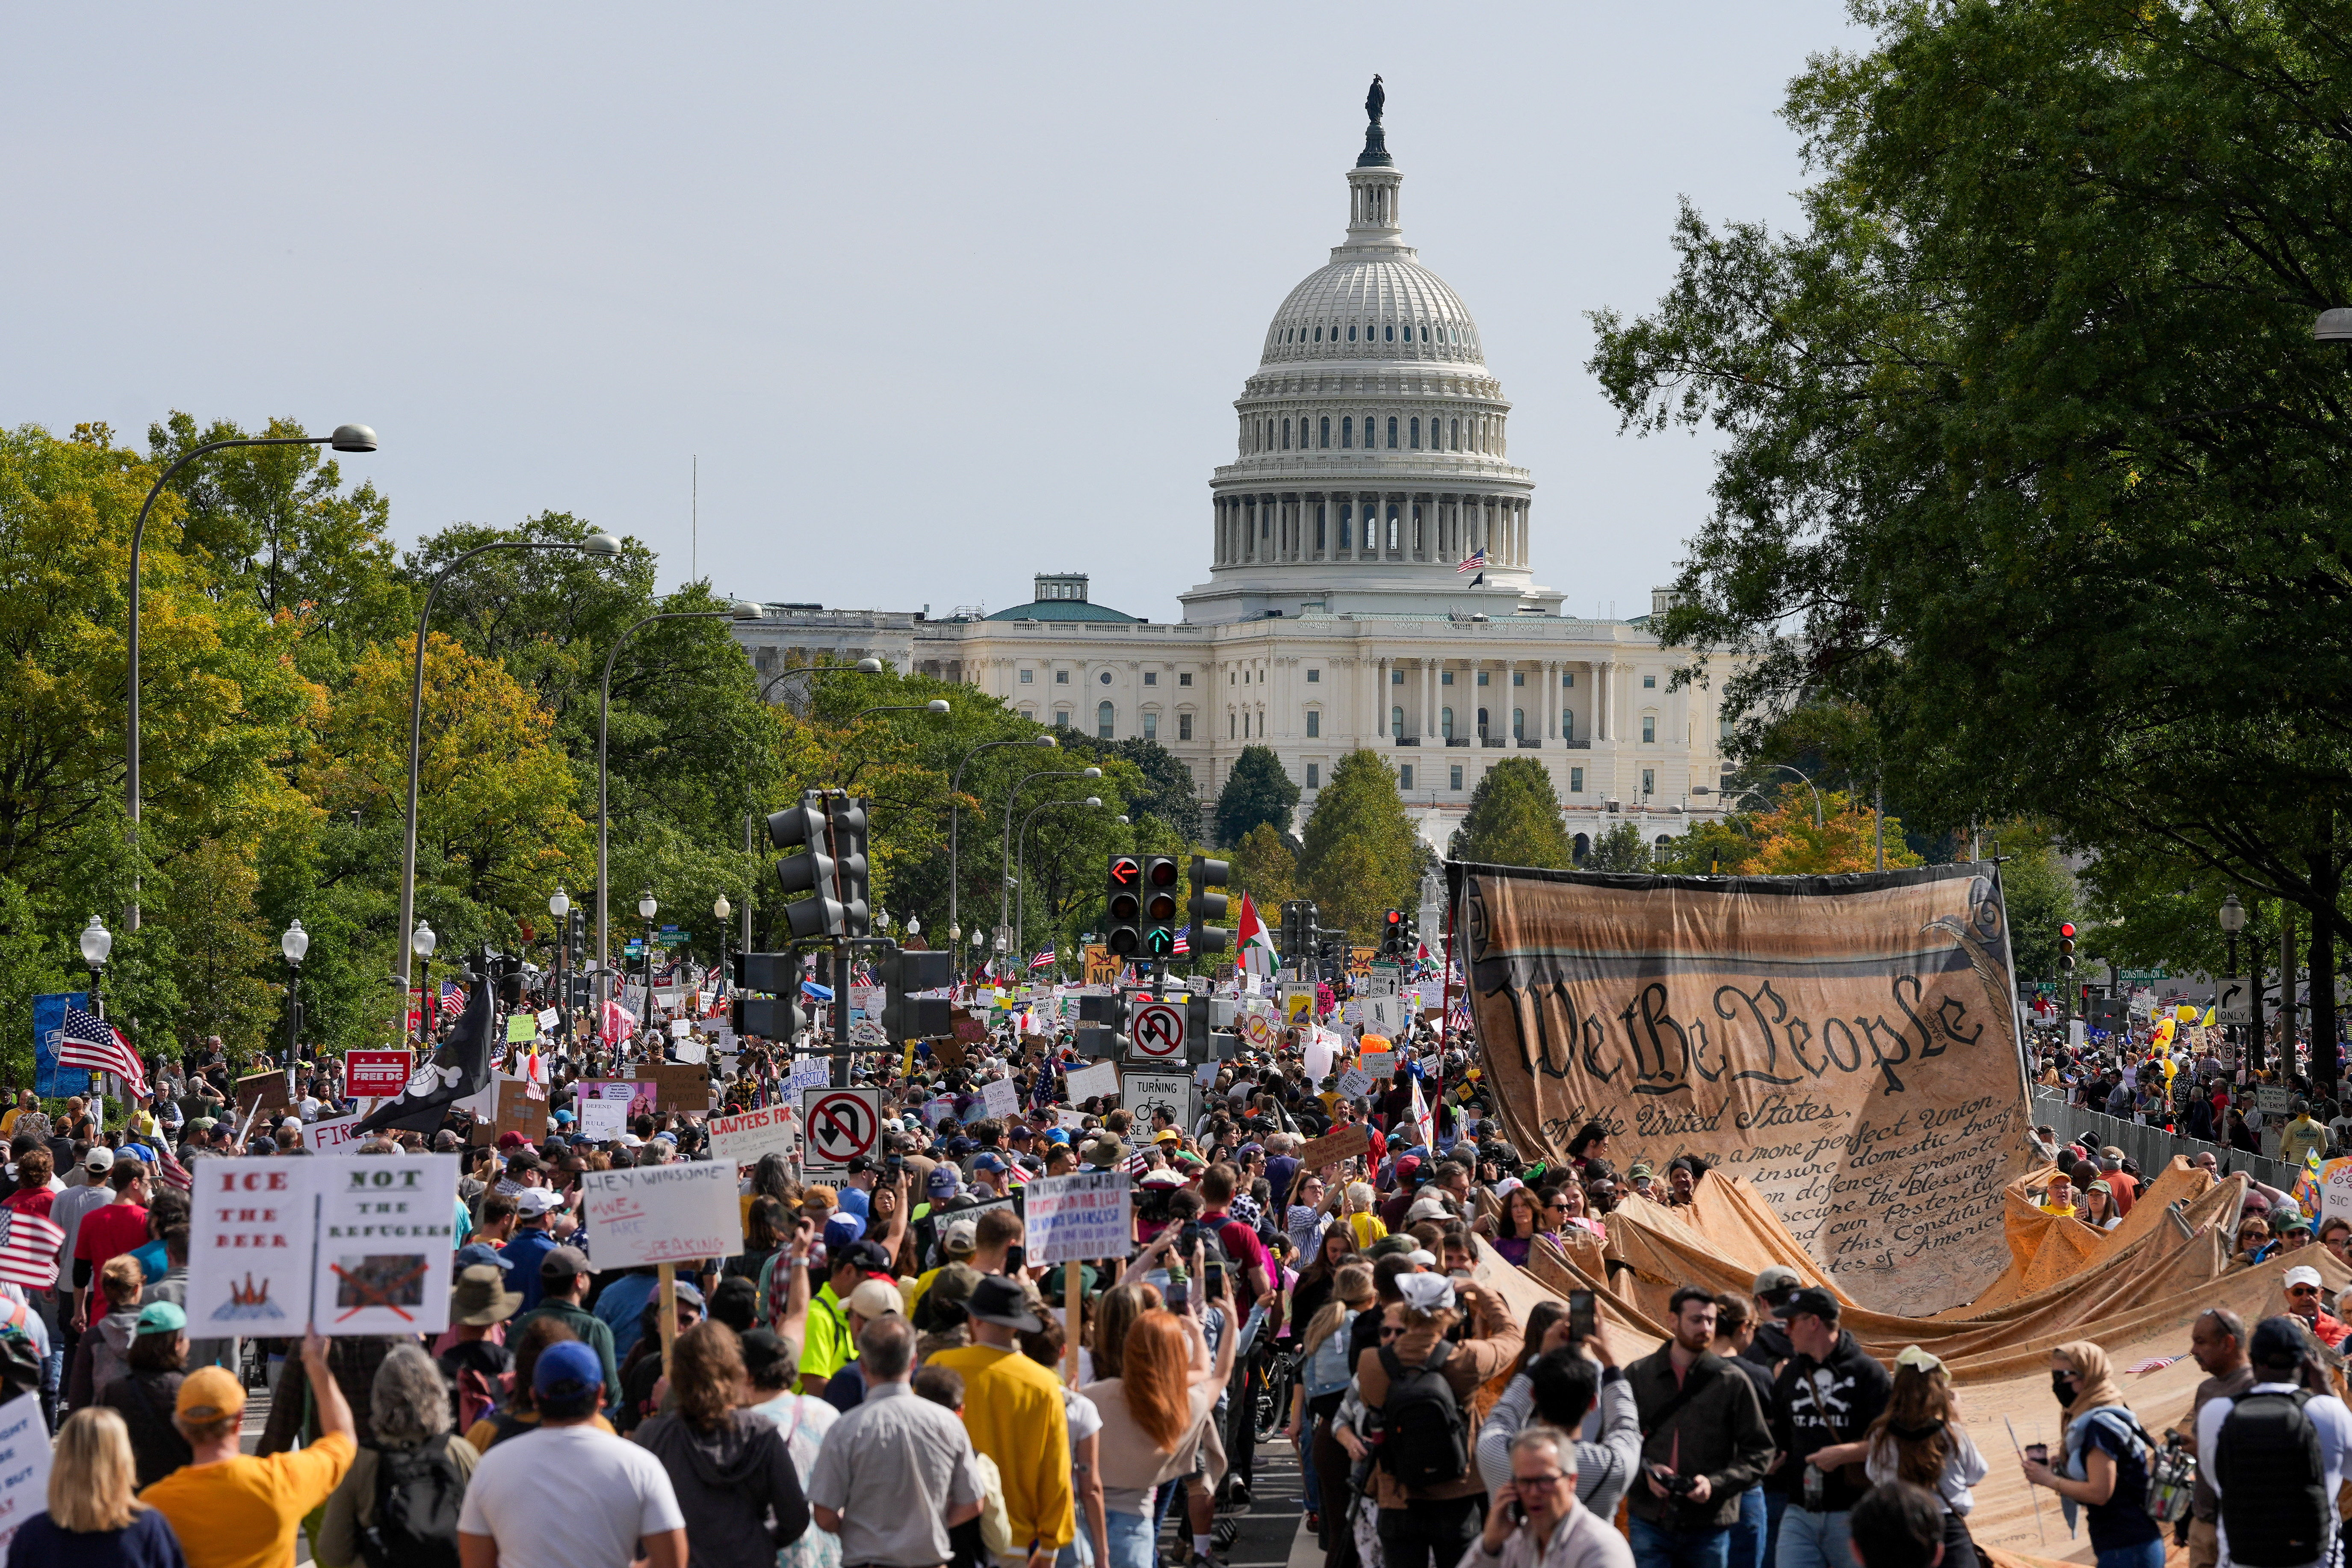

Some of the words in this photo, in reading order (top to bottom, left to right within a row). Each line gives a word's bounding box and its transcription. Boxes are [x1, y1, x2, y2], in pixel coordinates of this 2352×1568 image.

[1093, 968, 1116, 984] NO
[2121, 969, 2160, 979] CONSTITUTION
[1264, 1017, 1281, 1026] TELL
[2221, 1011, 2246, 1020] ONLY
[859, 1032, 875, 1040] FACISM
[1327, 1022, 1352, 1040] NOPE
[1486, 961, 1622, 1084] We
[1617, 982, 1727, 1086] the
[1714, 974, 1983, 1096] People
[1279, 1036, 1288, 1044] NO
[791, 1061, 801, 1075] I
[805, 1058, 826, 1072] LOVE
[353, 1072, 384, 1081] FREE
[386, 1072, 403, 1081] DC
[791, 1071, 828, 1088] AMERICA
[1349, 1070, 1368, 1086] MAGA?
[780, 1082, 791, 1094] HERIT
[1137, 1082, 1177, 1094] TURNING
[1344, 1080, 1356, 1090] FIRE
[710, 1112, 769, 1136] LAWYERS
[774, 1106, 792, 1124] FOR
[1540, 1104, 1585, 1147] of
[1586, 1104, 1627, 1137] the
[1636, 1097, 1730, 1137] United
[1735, 1093, 1851, 1131] States,
[1729, 1149, 1743, 1163] a
[1746, 1141, 1804, 1163] more
[1806, 1110, 1914, 1160] perfect
[1919, 1093, 2003, 1131] Union,
[1130, 1125, 1141, 1135] SE
[1750, 1160, 1836, 1183] insure
[1850, 1129, 1949, 1169] domestic
[1796, 1172, 1893, 1205] defence,
[1899, 1135, 2000, 1189] promote
[220, 1171, 289, 1192] ICE
[349, 1170, 423, 1188] NOT
[587, 1172, 634, 1194] HEY
[641, 1165, 725, 1186] WINSOME
[811, 1179, 848, 1191] TURN
[1781, 1199, 1856, 1223] secure
[1867, 1185, 1899, 1206] the
[1907, 1152, 2009, 1196] Blessings
[356, 1202, 408, 1214] THE
[2329, 1195, 2349, 1207] SIC
[216, 1208, 278, 1223] THE
[1790, 1219, 1826, 1241] nd
[1829, 1217, 1868, 1235] our
[1881, 1178, 2006, 1223] Posterity
[329, 1225, 451, 1237] REFUGEES
[611, 1220, 647, 1236] ARE
[1838, 1234, 1884, 1255] this
[1894, 1191, 2006, 1241] Constituti
[215, 1234, 289, 1248] BEER
[631, 1236, 724, 1260] SPEAKING
[1870, 1248, 1895, 1270] of
